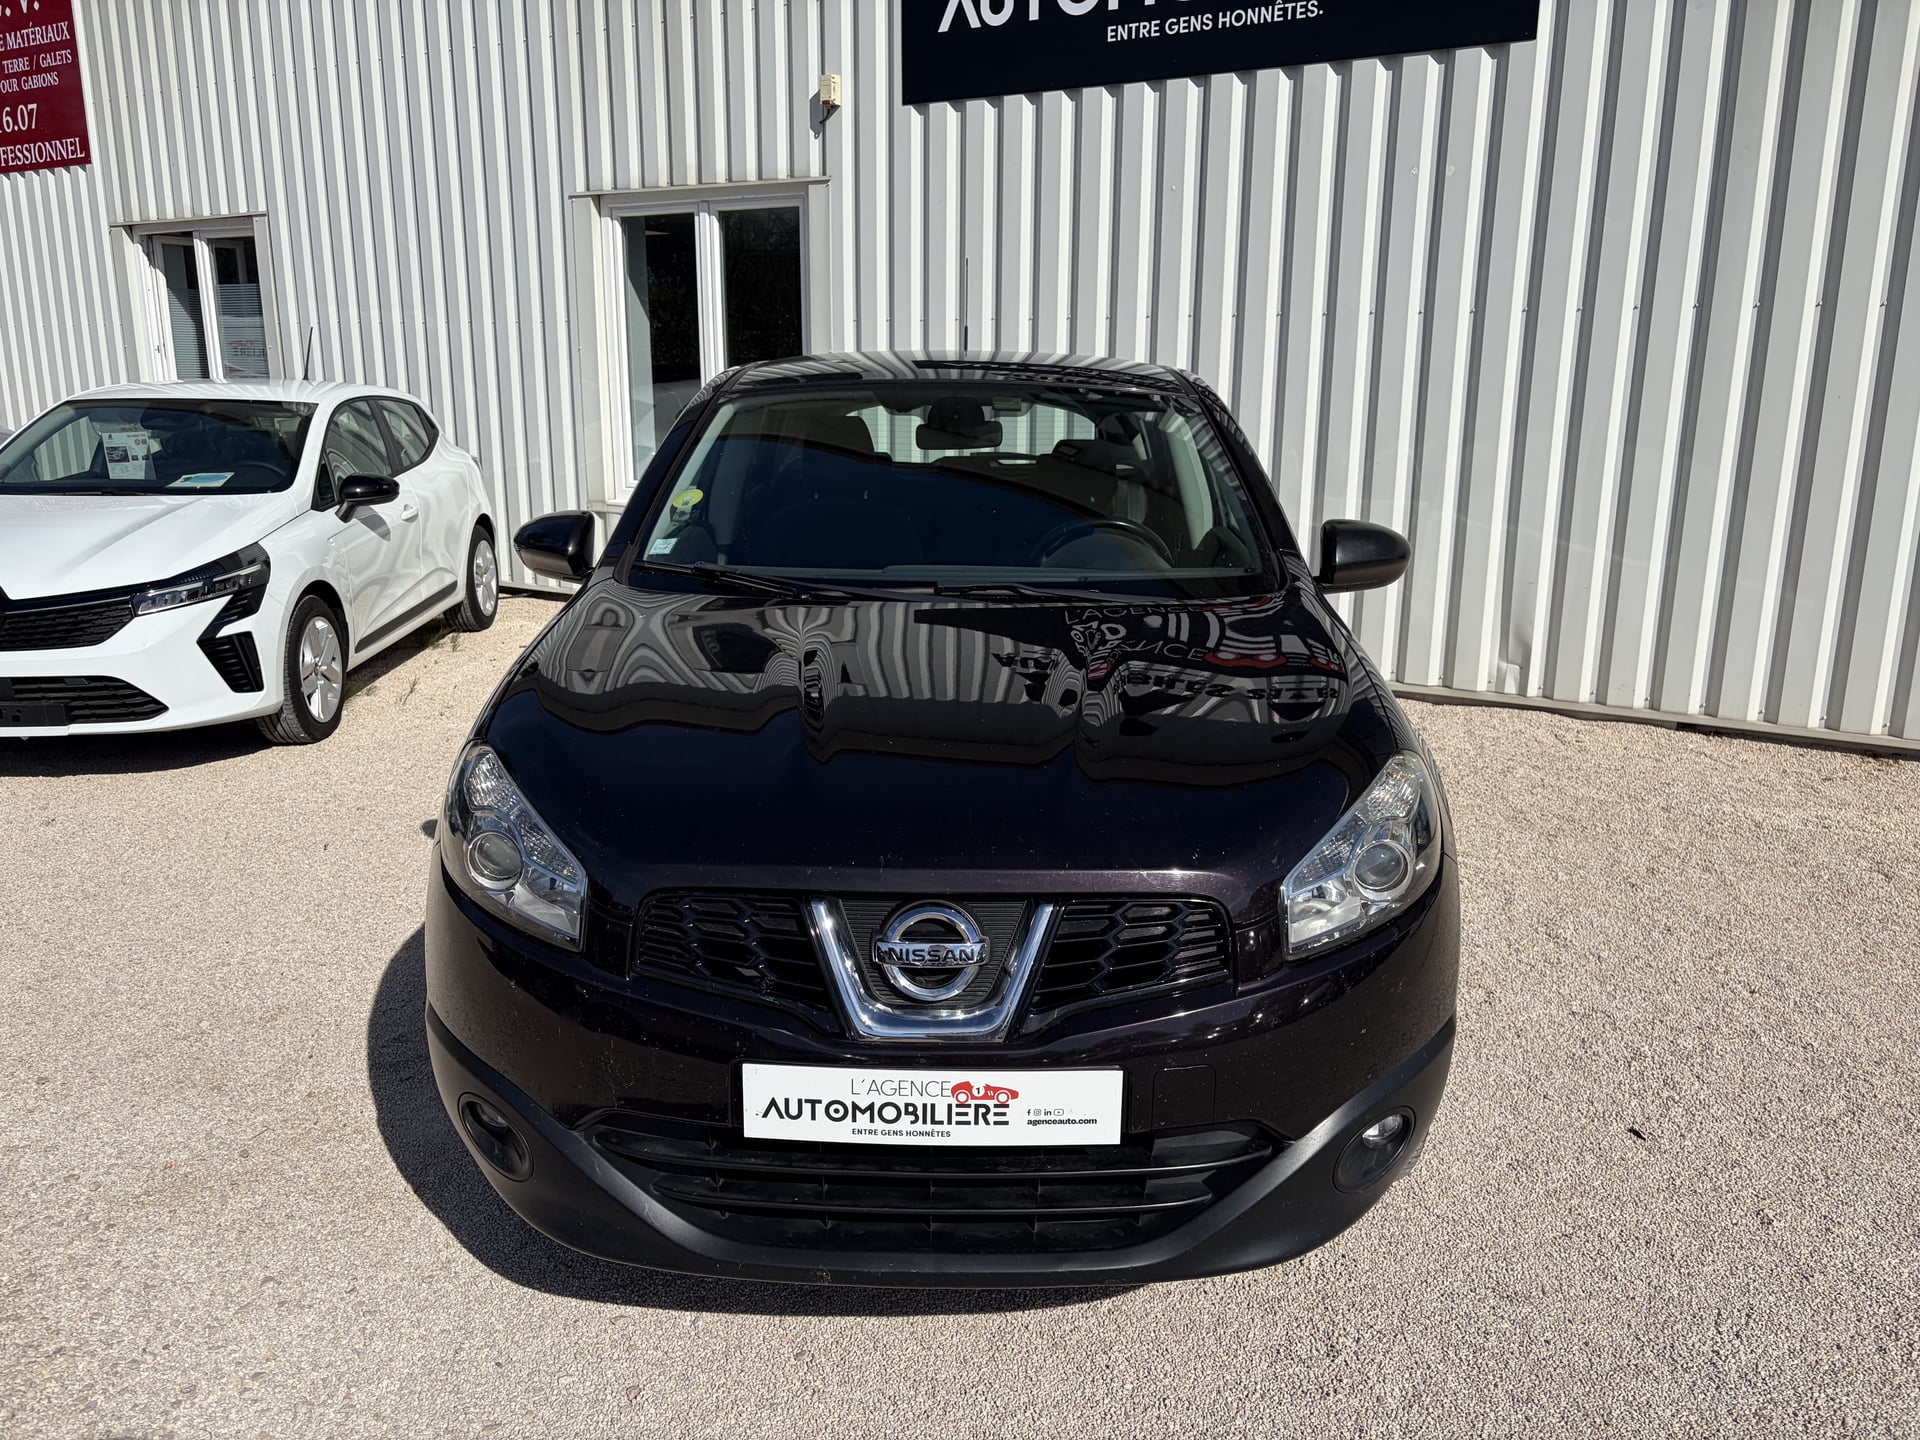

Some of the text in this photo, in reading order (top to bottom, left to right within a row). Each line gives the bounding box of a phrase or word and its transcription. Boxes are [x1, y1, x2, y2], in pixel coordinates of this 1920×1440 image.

[6, 21, 70, 50] MATÉRIAUX
[1106, 20, 1161, 42] ENTRE
[1165, 13, 1213, 35] GENS
[2, 57, 30, 74] TERRE
[40, 49, 72, 68] GALETS
[21, 71, 59, 90] GABIONS
[0, 103, 37, 133] 6.07
[887, 947, 975, 962] NISSAN
[851, 1078, 951, 1098] L'AGENCE
[1026, 1118, 1098, 1127] agenceauto.com
[852, 1128, 951, 1138] ENTRE GENS HONNÊTES
